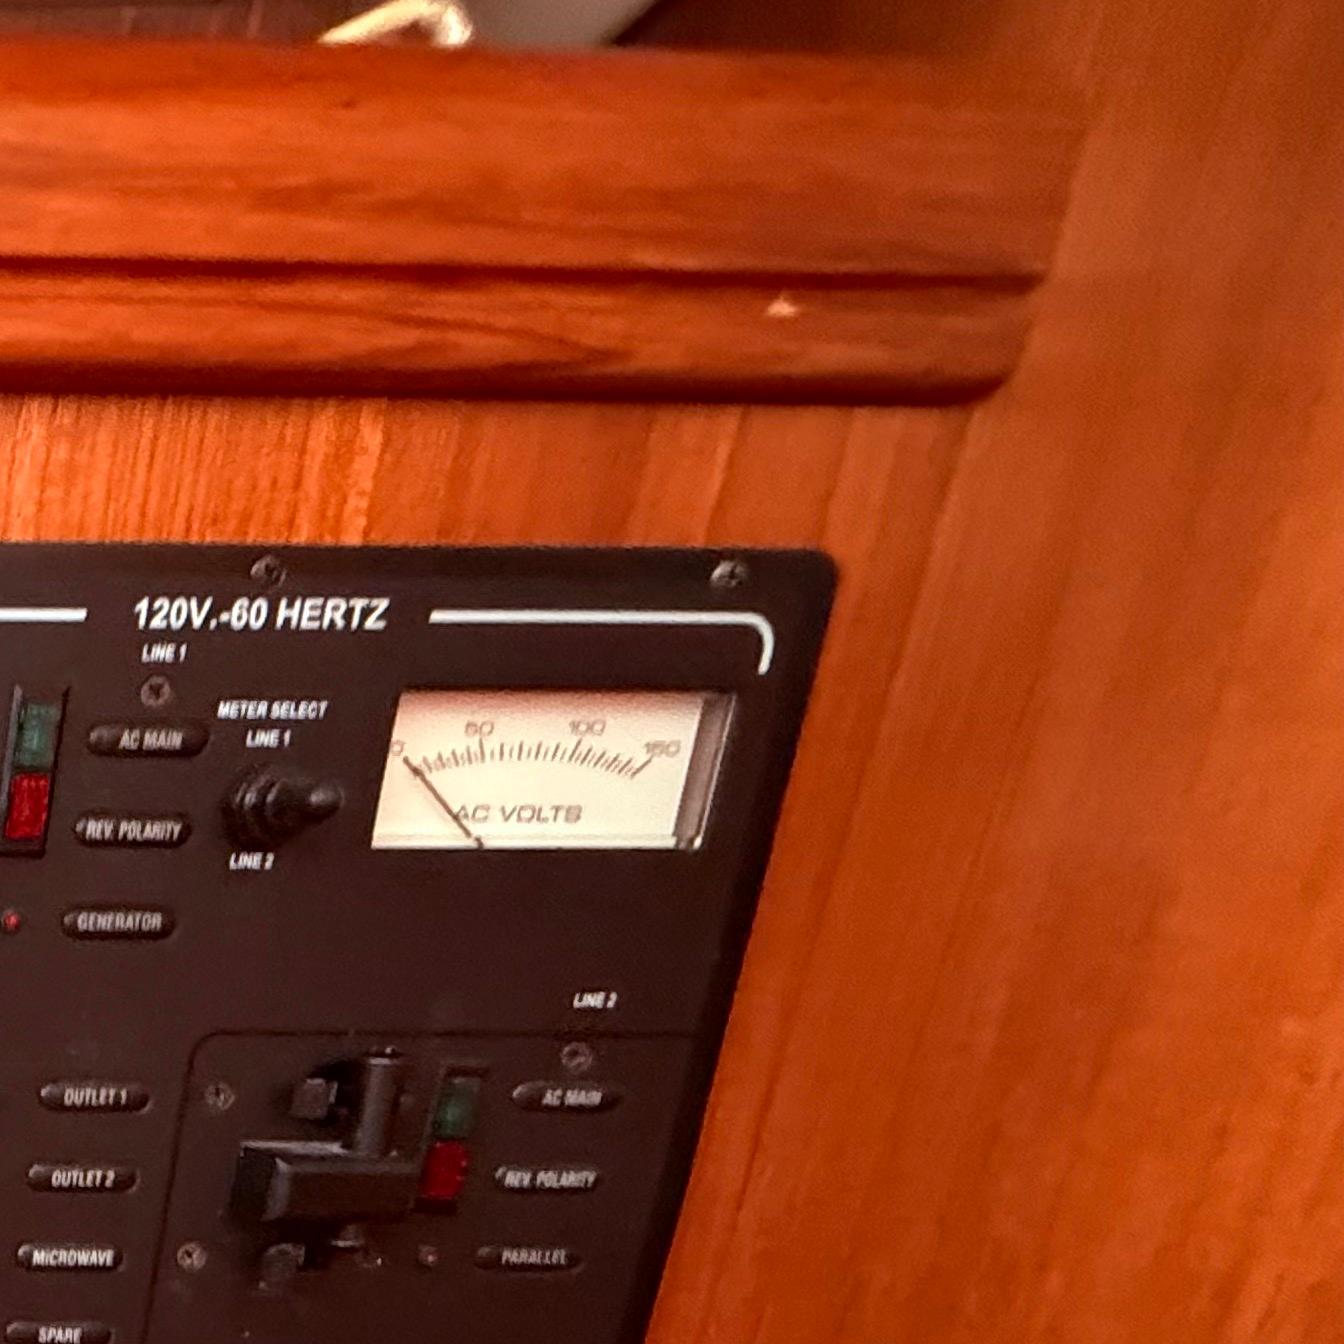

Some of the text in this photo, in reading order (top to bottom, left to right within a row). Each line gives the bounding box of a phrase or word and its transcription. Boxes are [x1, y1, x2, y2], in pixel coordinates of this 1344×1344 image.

[275, 596, 390, 631] HERTZ
[142, 643, 187, 663] LINE 1
[217, 700, 328, 720] METER SELECT
[465, 721, 495, 736] 50
[568, 720, 606, 736] 100
[118, 728, 183, 750] AC MAIN
[246, 729, 291, 747] LINE 1
[643, 740, 681, 757] 150
[455, 804, 583, 824] AC VOLTS
[118, 819, 182, 841] POLARITY
[229, 852, 275, 870] LINE 2
[77, 912, 162, 932] GENERATOR
[573, 992, 604, 1009] LINE
[63, 1087, 127, 1106] OUTLET 1
[542, 1089, 602, 1107] AC MAIN
[50, 1170, 102, 1188] OUTLET
[536, 1170, 598, 1189] POLARITY
[32, 1249, 114, 1267] MICROWAVE
[502, 1249, 566, 1266] PARALLEL
[38, 1327, 82, 1344] SPARE
